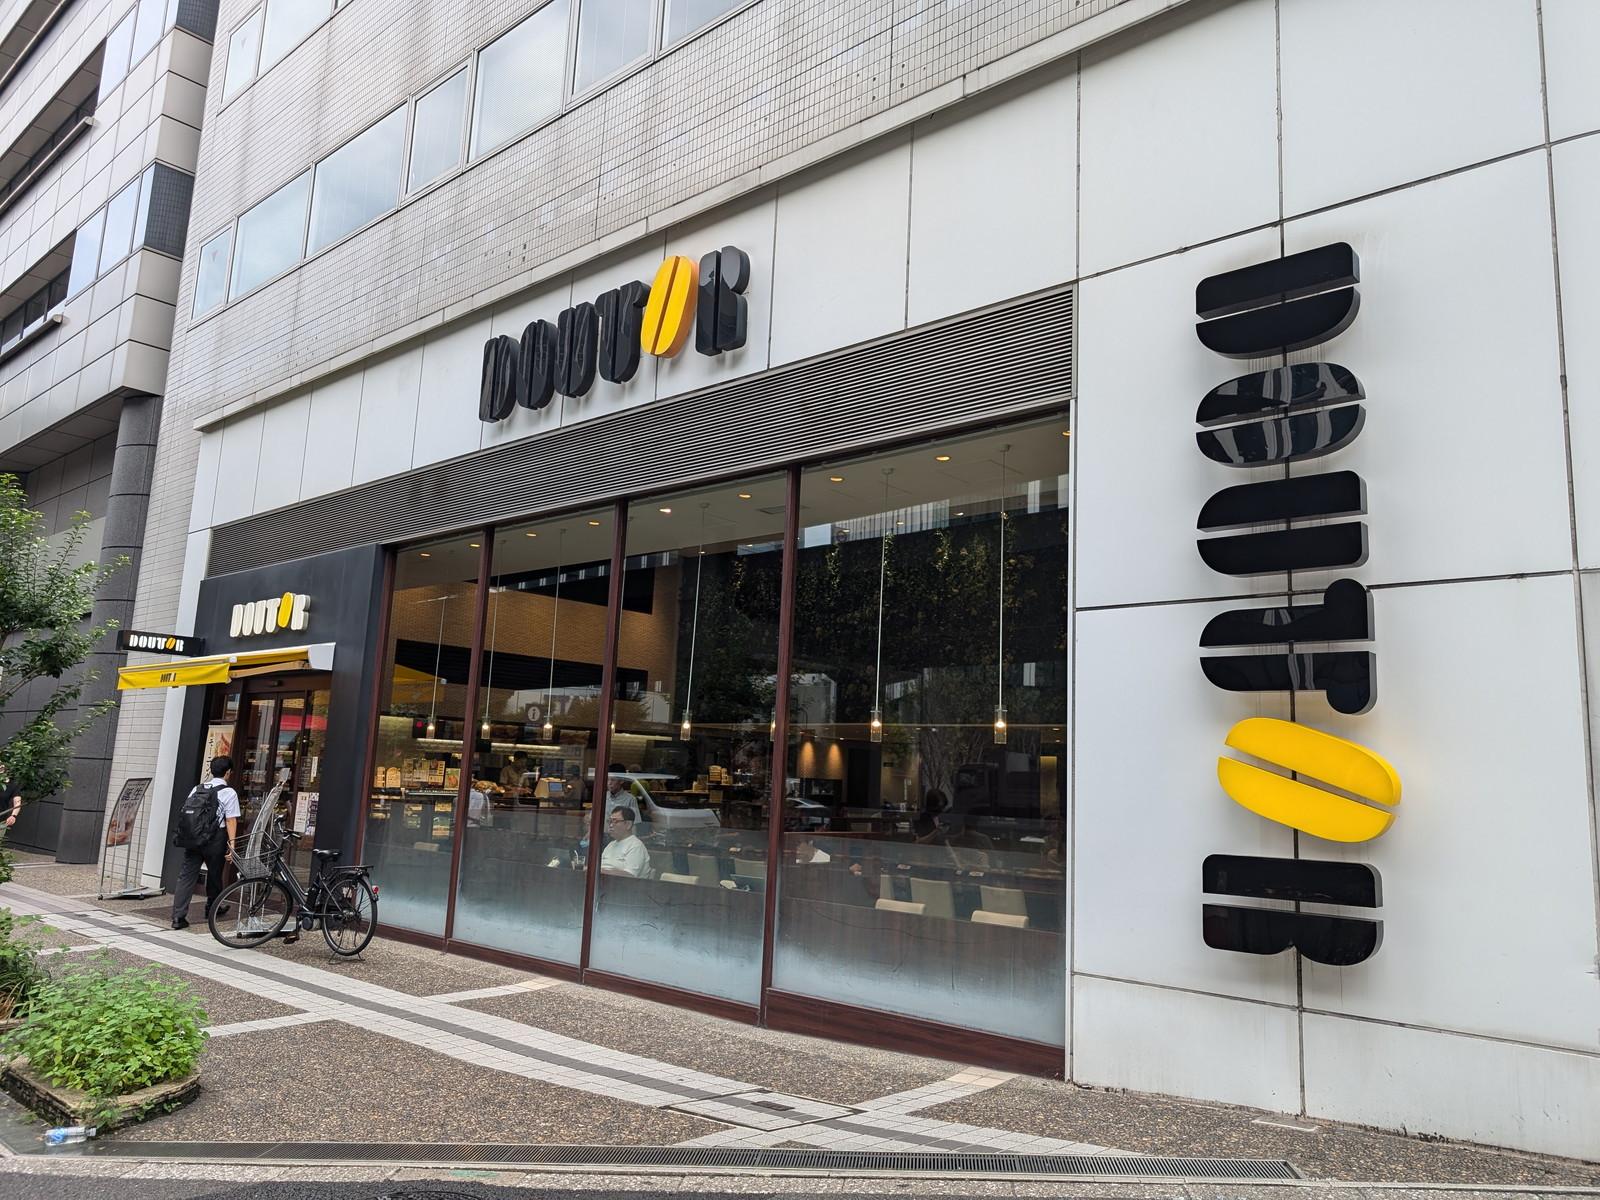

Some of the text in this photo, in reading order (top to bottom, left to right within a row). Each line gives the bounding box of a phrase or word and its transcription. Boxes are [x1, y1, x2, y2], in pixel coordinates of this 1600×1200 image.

[479, 245, 750, 423] DOUTOR
[129, 634, 184, 651] DOUTOR
[230, 592, 311, 637] DOUTOR
[1195, 242, 1402, 966] DOUTOR
